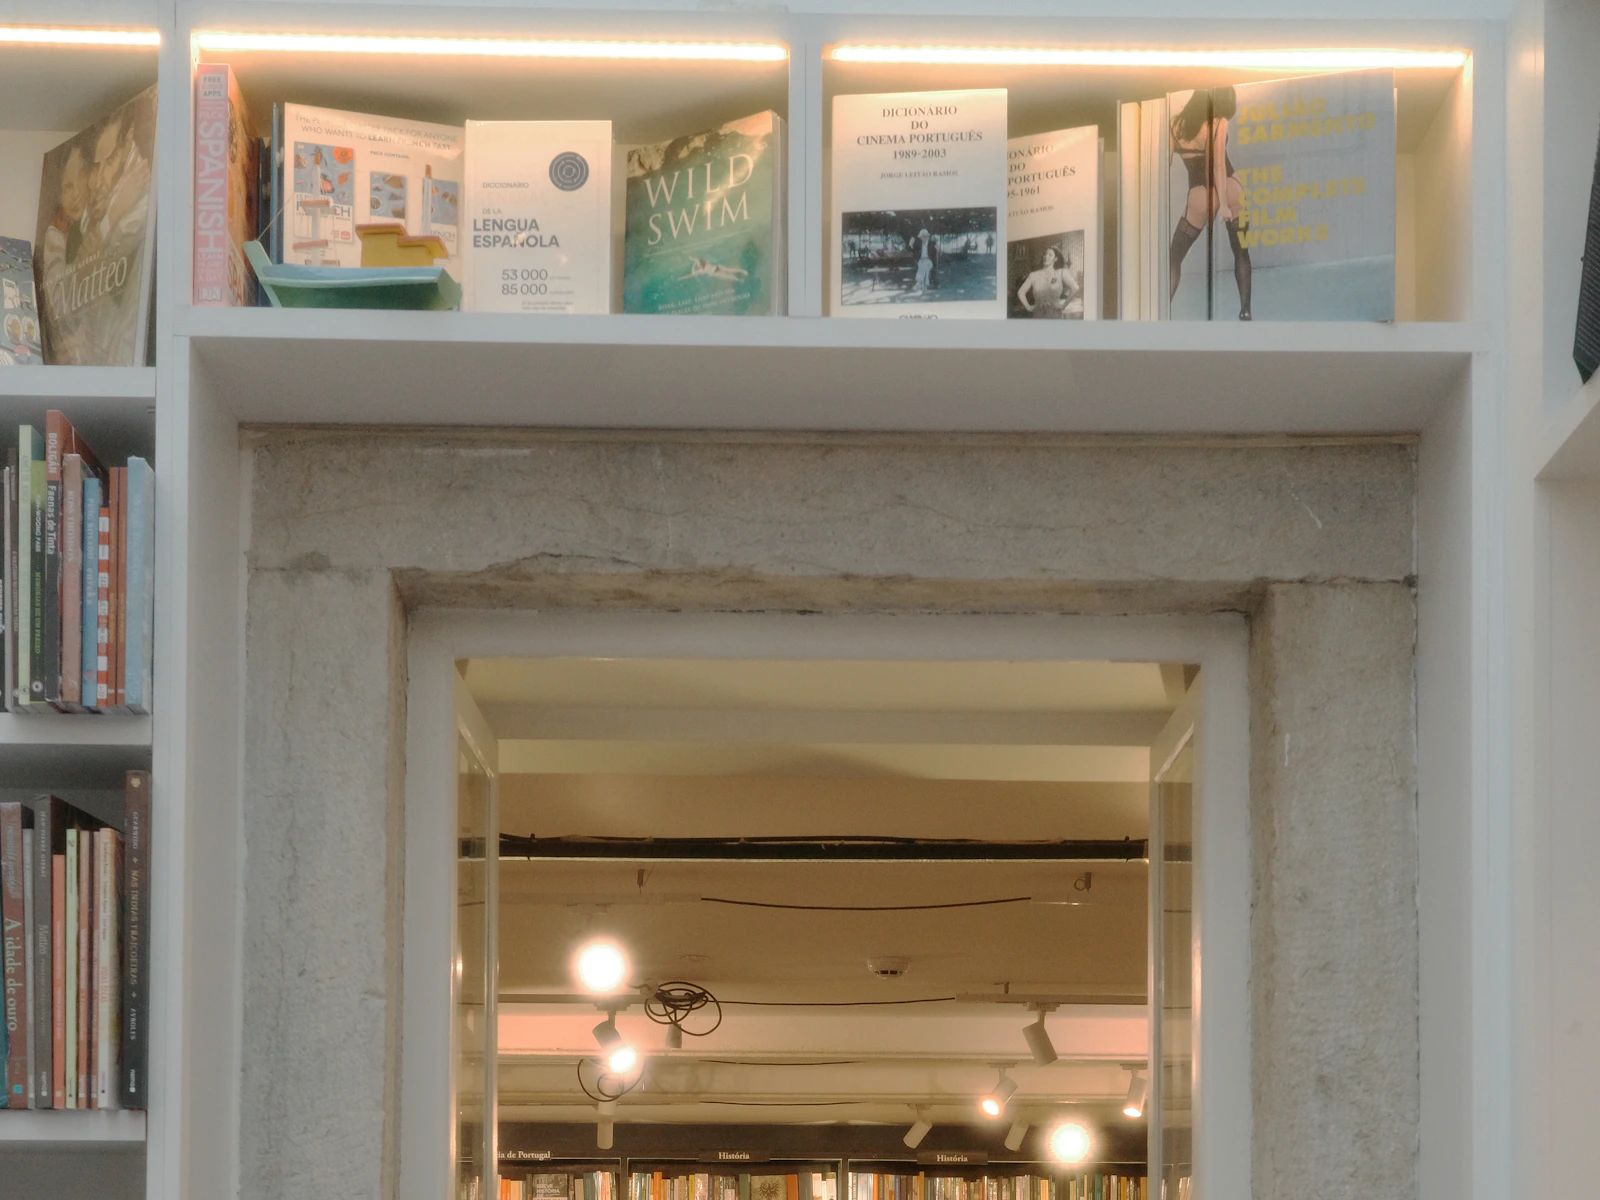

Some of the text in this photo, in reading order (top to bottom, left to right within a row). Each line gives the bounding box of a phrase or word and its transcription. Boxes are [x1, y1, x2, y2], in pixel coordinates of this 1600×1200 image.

[882, 105, 958, 118] DICIONÁRIO
[911, 120, 929, 130] DO
[1238, 112, 1377, 145] SARMENTO
[857, 129, 983, 146] CINEMA PORTUGUÊS
[893, 149, 947, 160] 1989-2003
[1008, 166, 1076, 186] PORTUGUÊS
[1009, 162, 1026, 172] DO
[198, 121, 226, 252] SPANISH
[644, 153, 754, 208] WILD
[1238, 177, 1365, 206] COMPLETE
[473, 219, 540, 232] LENGUA
[648, 191, 750, 246] SWIM
[1238, 206, 1297, 228] FILM
[473, 231, 560, 248] ESPAÑOLA
[1237, 223, 1329, 249] WORKS
[501, 268, 548, 281] 53 000
[501, 283, 548, 296] 85 000
[48, 432, 59, 475] BOLIGÁN
[47, 485, 57, 517] Faenas
[47, 532, 57, 555] Tinta
[4, 917, 23, 1032] A idade de ouro
[518, 1150, 551, 1161] Portugal
[718, 1151, 750, 1160] História
[936, 1154, 968, 1163] História
